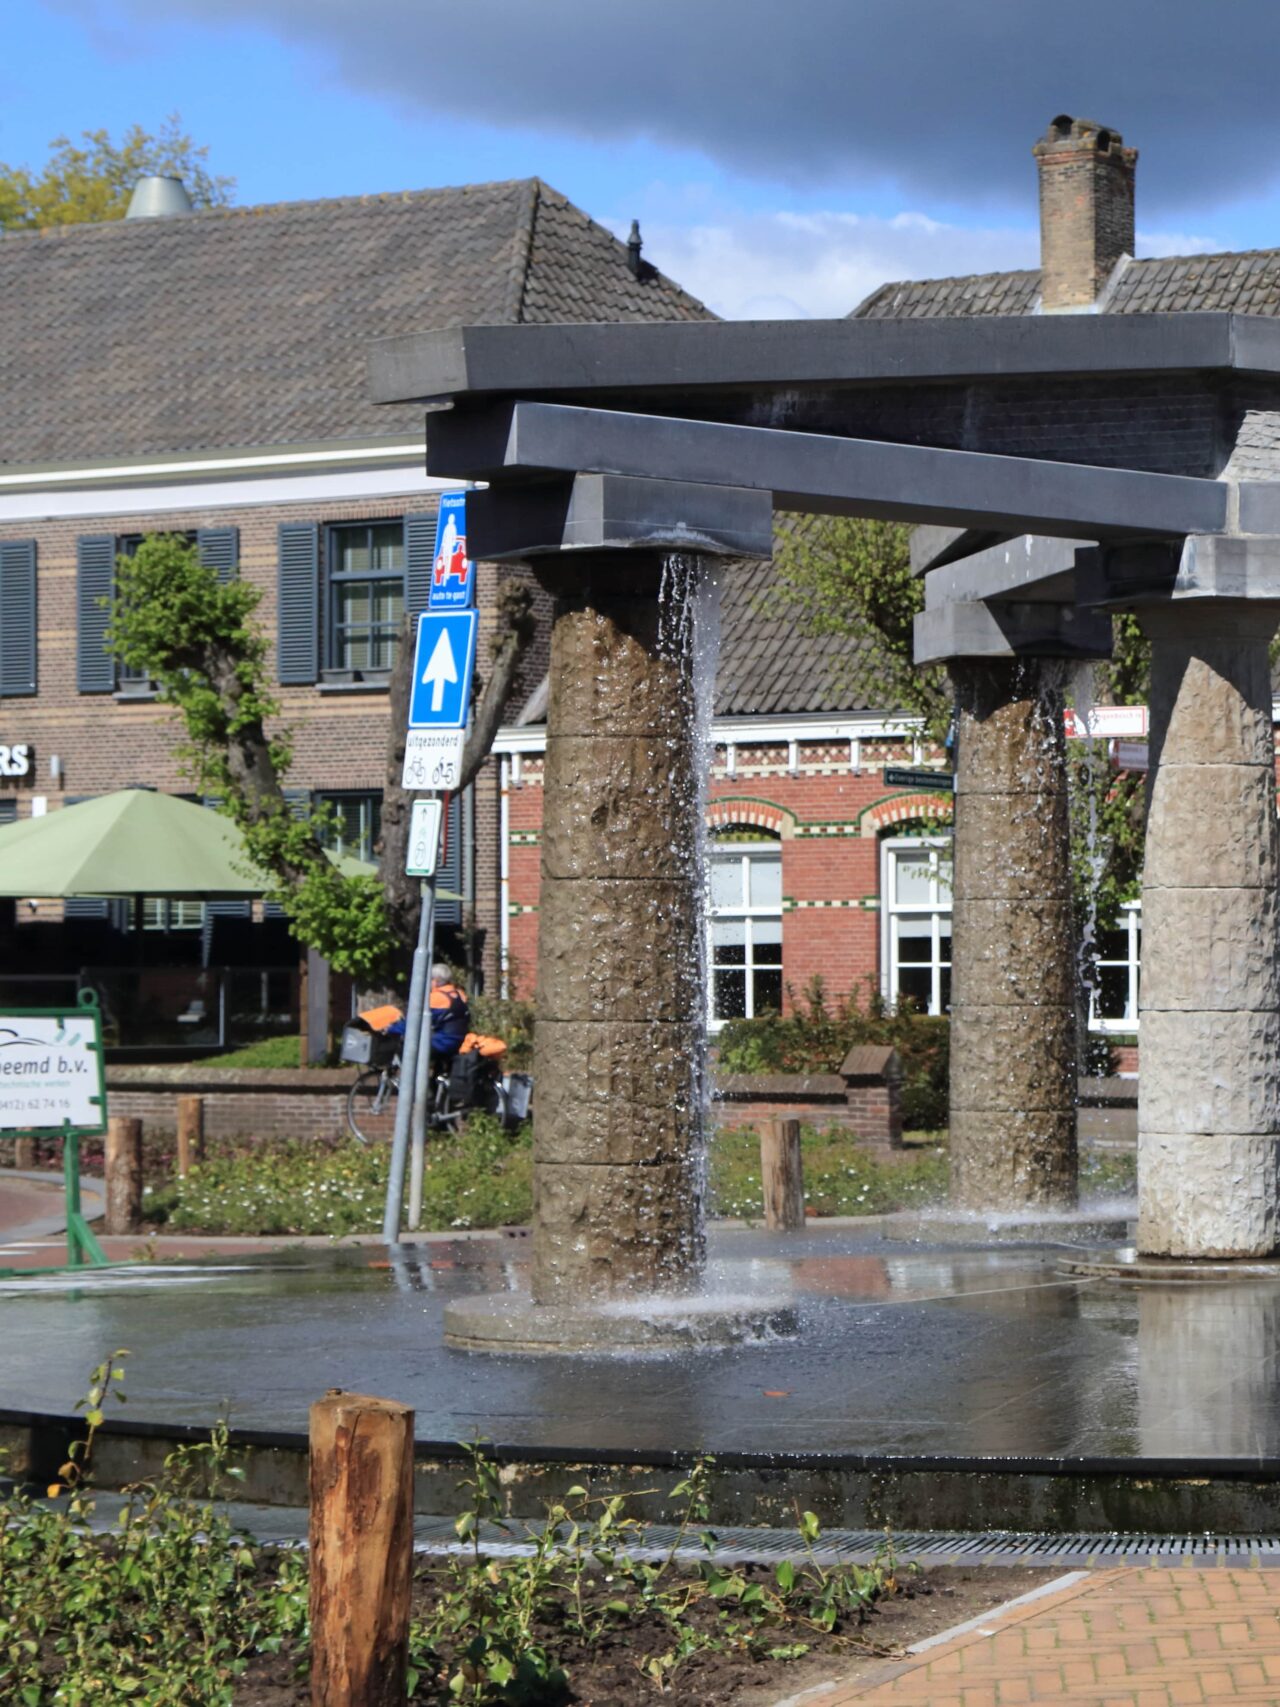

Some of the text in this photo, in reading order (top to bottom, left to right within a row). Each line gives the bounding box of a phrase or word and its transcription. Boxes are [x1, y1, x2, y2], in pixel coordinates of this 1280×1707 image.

[432, 591, 465, 602] auto te gast
[408, 735, 459, 749] uitgezonderd
[57, 1056, 88, 1073] b.v.
[44, 1080, 70, 1088] werken
[28, 1098, 39, 1110] 62
[42, 1098, 55, 1110] 74
[58, 1098, 70, 1109] 16
